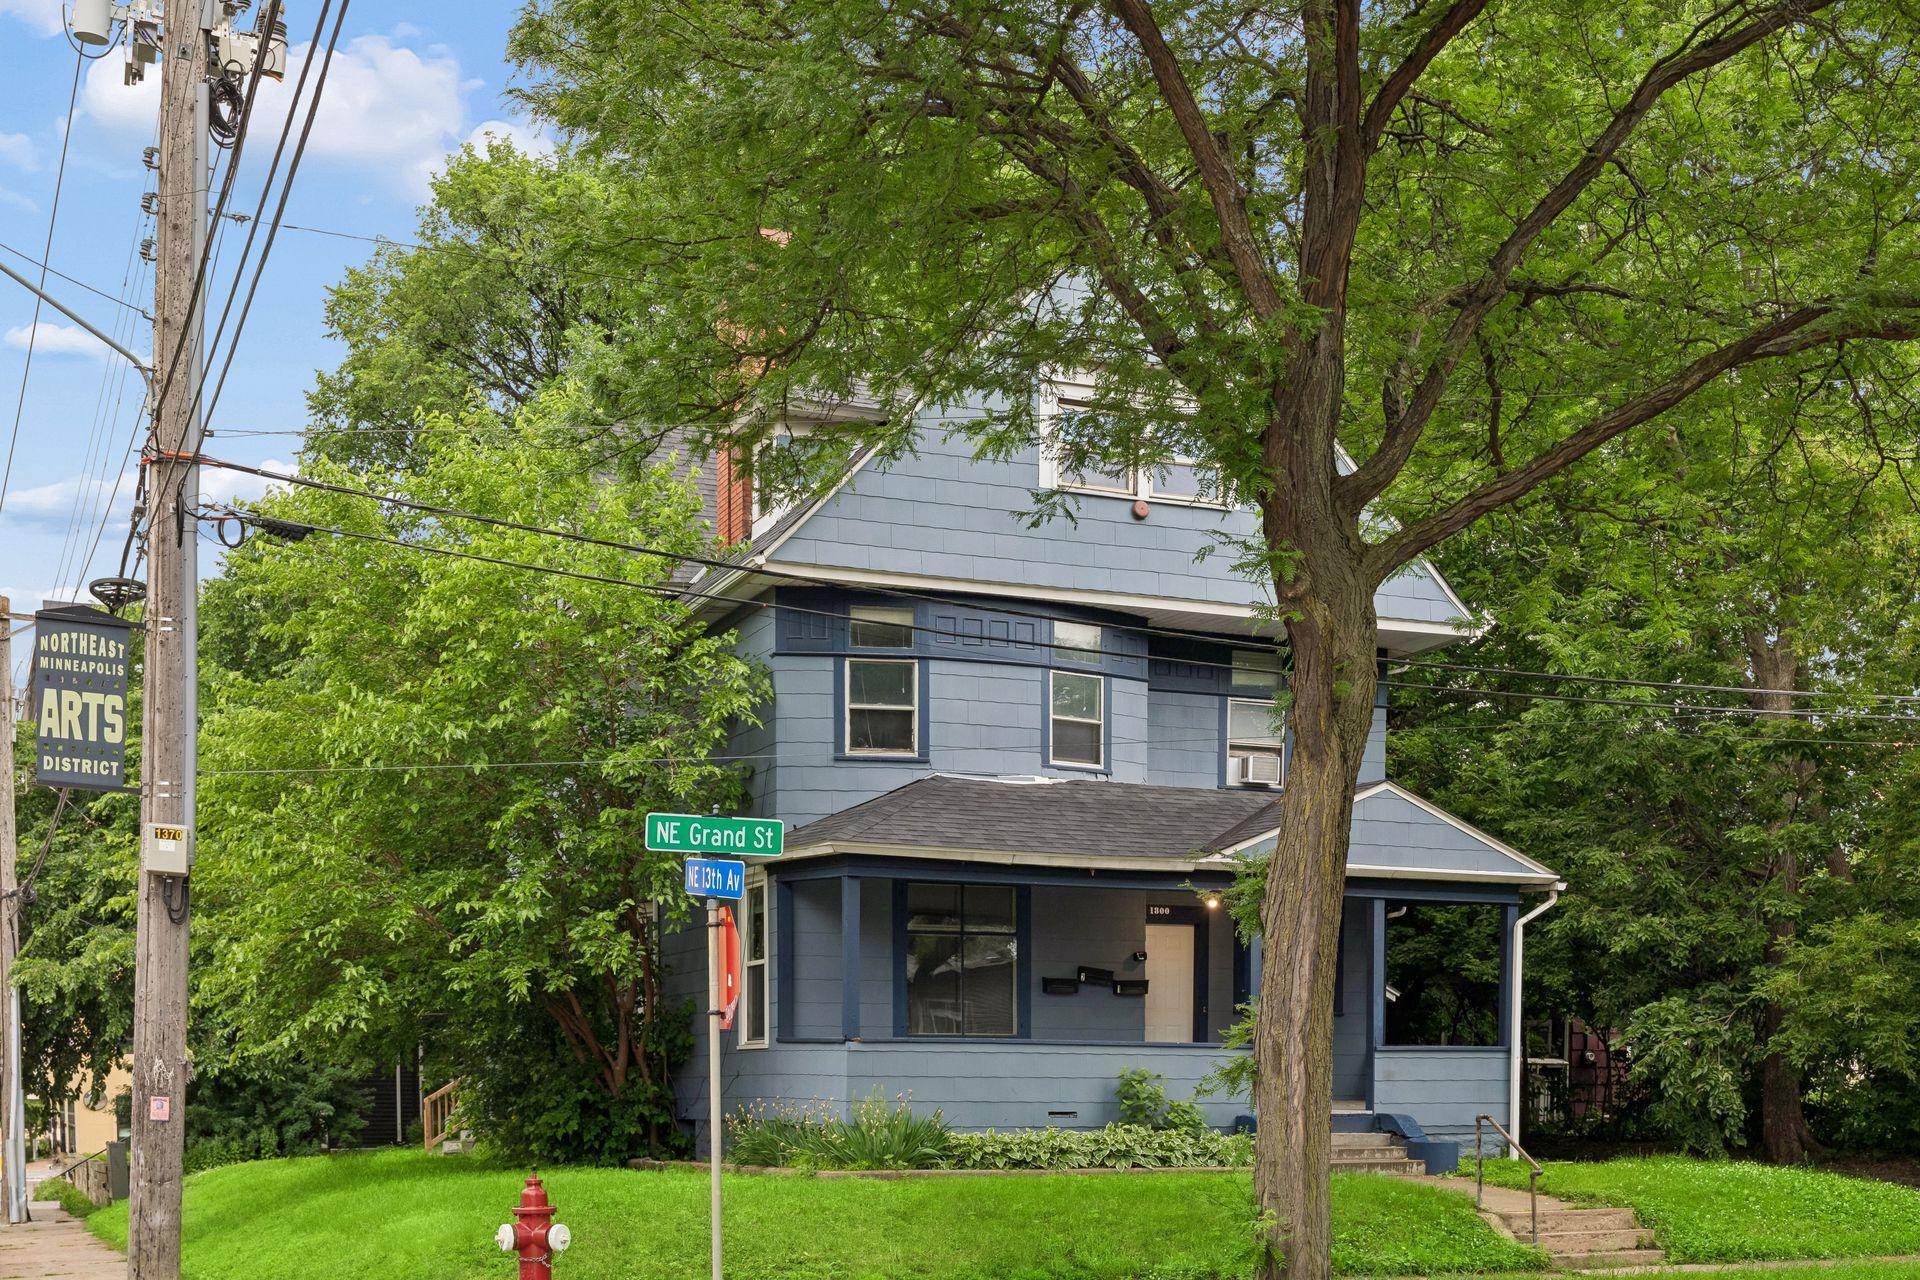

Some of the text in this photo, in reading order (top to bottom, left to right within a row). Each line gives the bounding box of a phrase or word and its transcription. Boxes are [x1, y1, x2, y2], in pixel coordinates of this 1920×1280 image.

[40, 632, 125, 659] NORTHEAST
[40, 656, 124, 676] MINNEAPOLIS
[39, 688, 124, 744] ARTS
[43, 755, 119, 776] DISTRICT
[155, 828, 183, 841] 1370
[656, 821, 774, 849] NE Grand St
[688, 865, 740, 892] NE 13th Av
